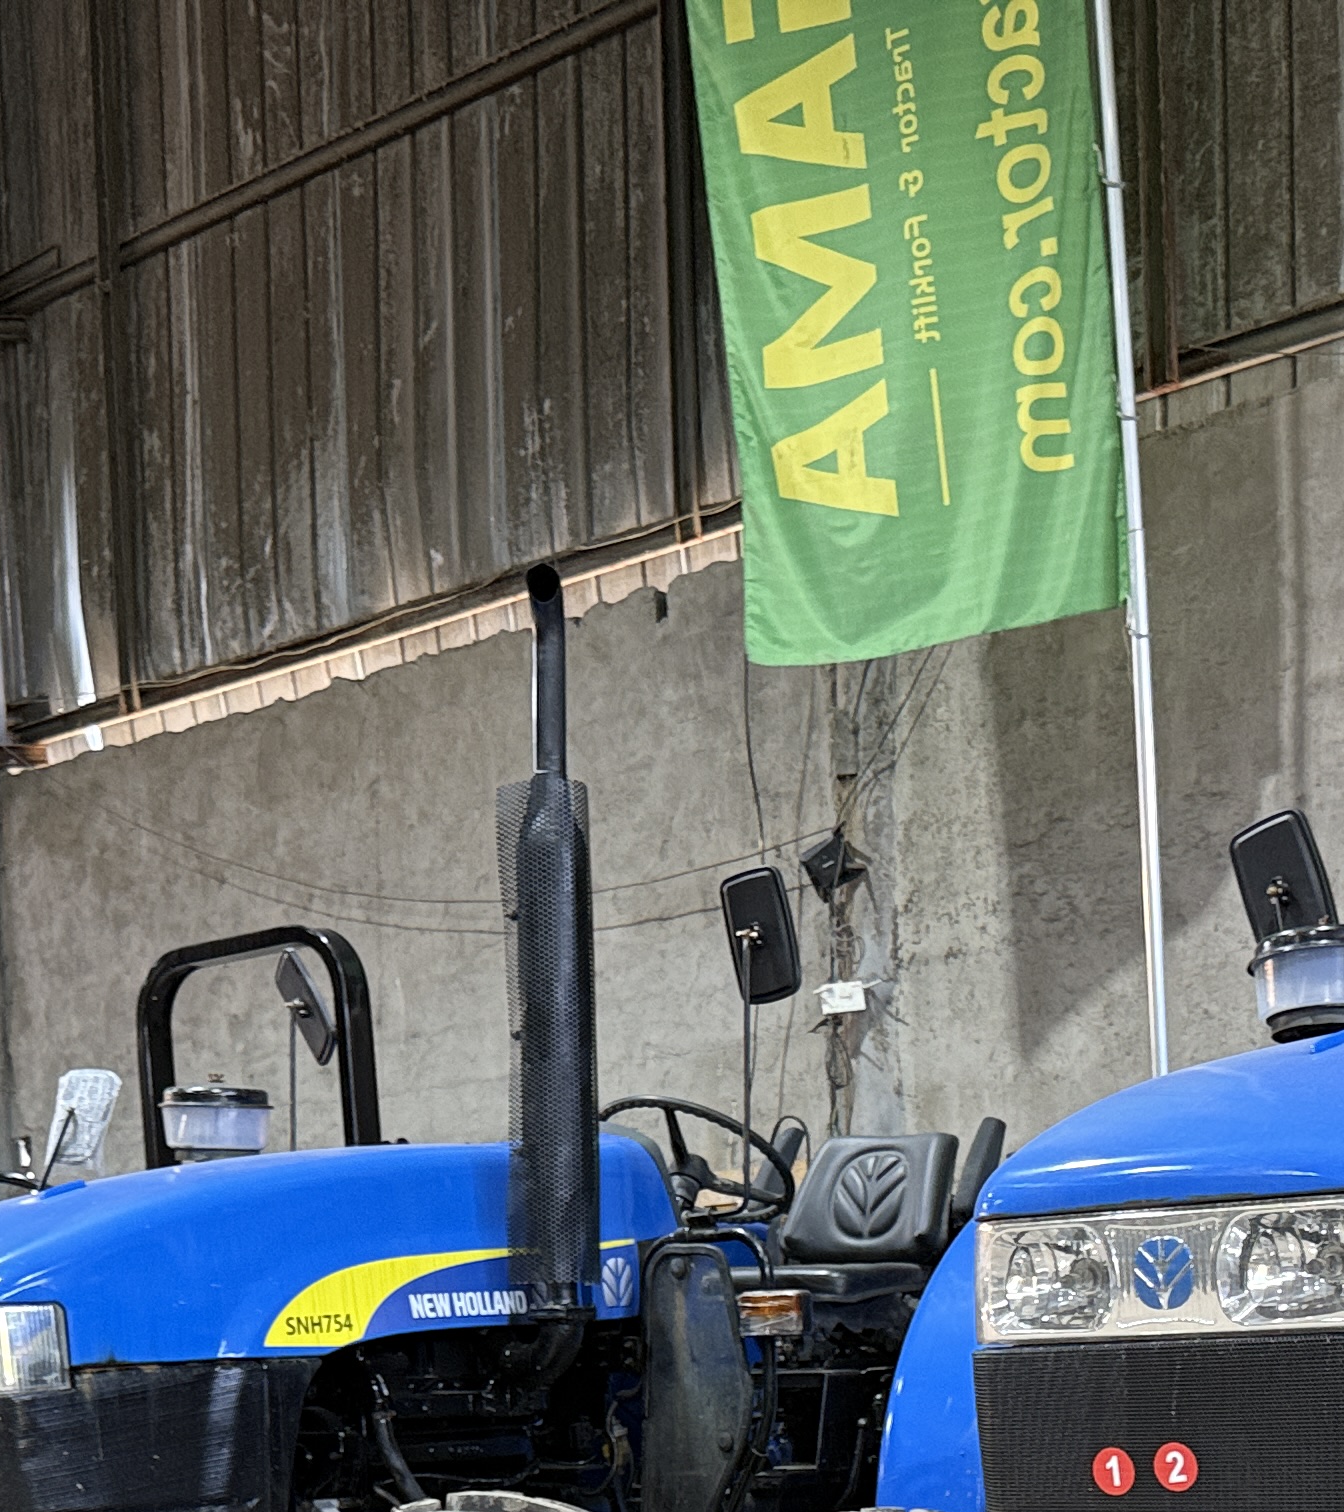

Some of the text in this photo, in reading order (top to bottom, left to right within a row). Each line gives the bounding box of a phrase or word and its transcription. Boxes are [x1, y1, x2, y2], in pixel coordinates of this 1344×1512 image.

[409, 1290, 527, 1320] NEW HOLLAND
[285, 1314, 353, 1336] SNH754
[1106, 1451, 1188, 1487] 1 2
